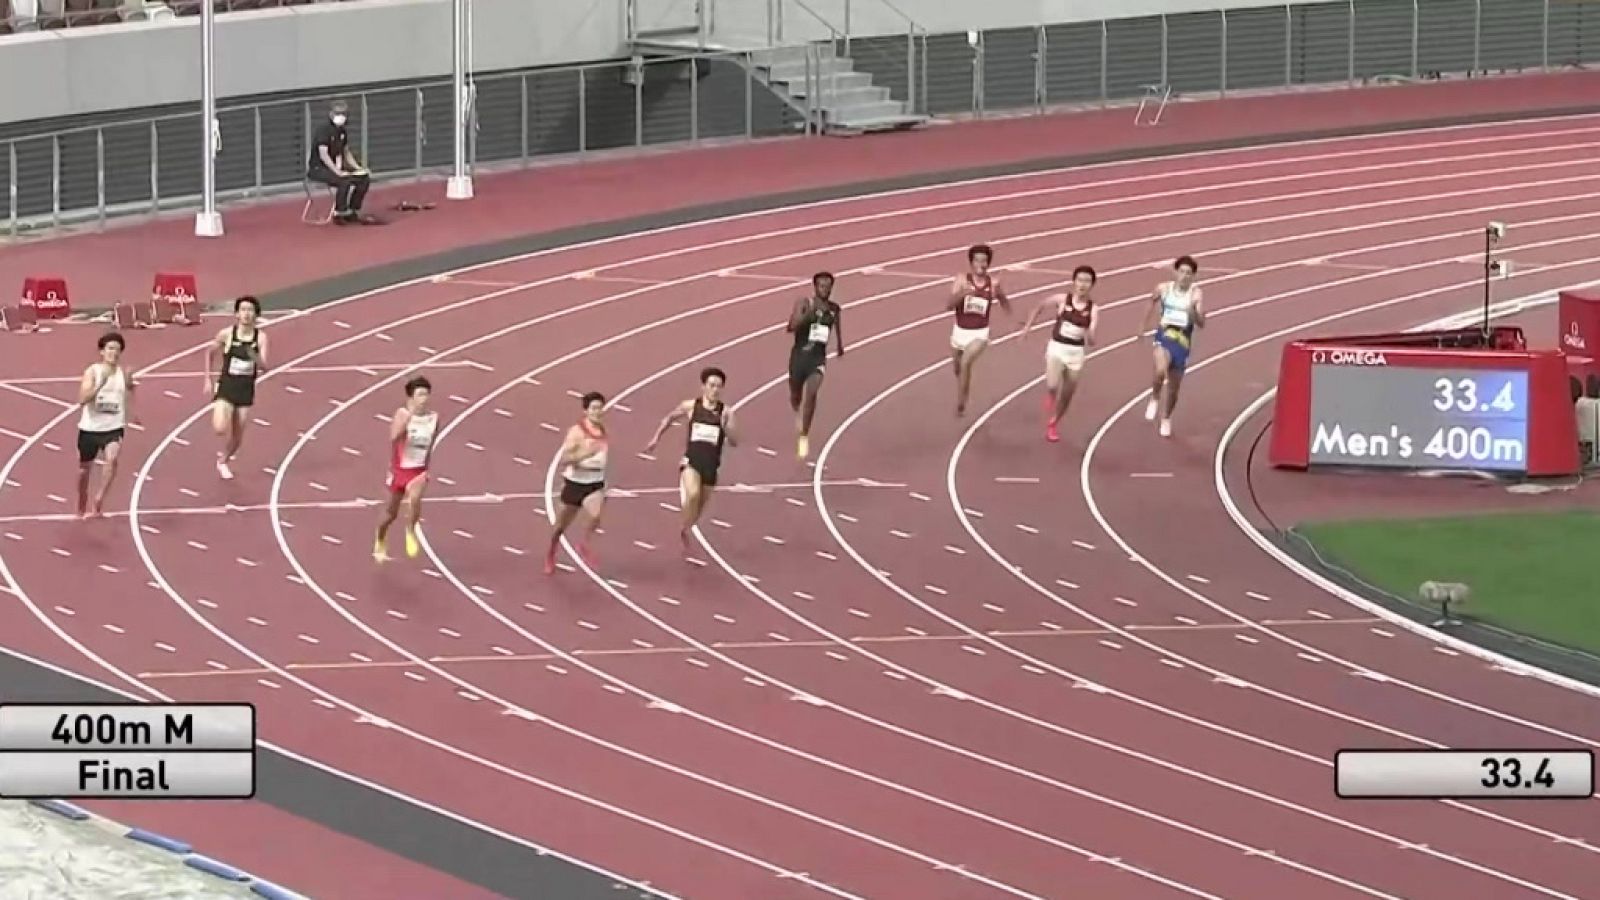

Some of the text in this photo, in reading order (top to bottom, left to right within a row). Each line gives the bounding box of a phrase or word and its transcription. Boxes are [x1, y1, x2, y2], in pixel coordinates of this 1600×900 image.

[37, 299, 68, 308] OMEGA
[1331, 352, 1387, 365] OMEGA
[1433, 378, 1515, 412] 33.4
[1311, 423, 1523, 461] Men's 400m
